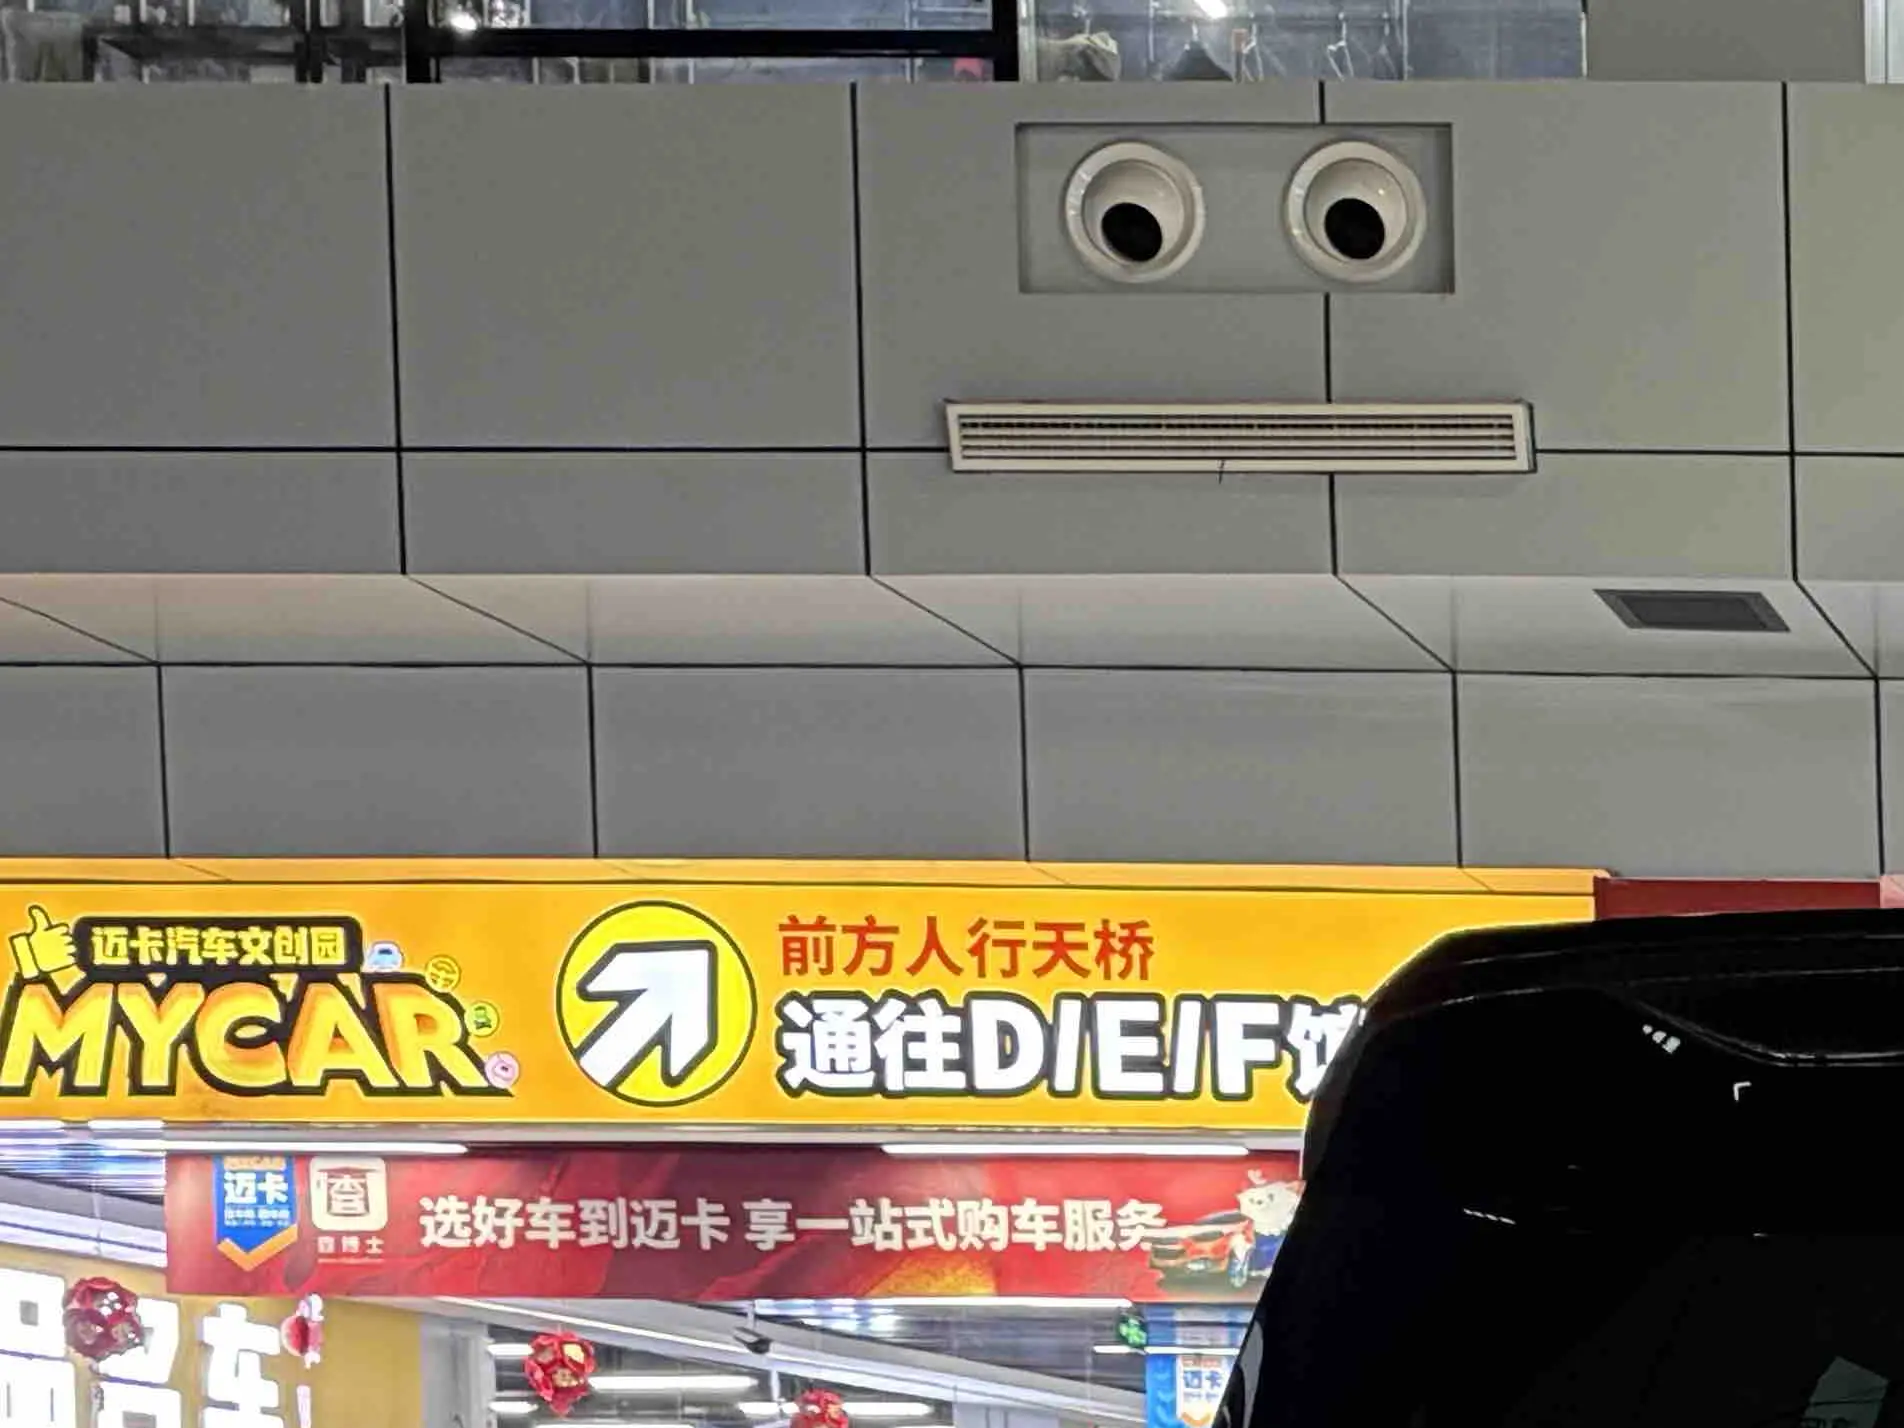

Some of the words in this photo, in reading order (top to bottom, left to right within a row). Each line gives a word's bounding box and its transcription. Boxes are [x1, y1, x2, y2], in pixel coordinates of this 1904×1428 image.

[91, 925, 346, 966] 迈卡汽车文创园
[778, 915, 1155, 981] 前方人行天桥
[0, 976, 492, 1094] MYCAR
[224, 1171, 290, 1204] 迈卡
[419, 1195, 731, 1251] 选好车到迈卡
[744, 1196, 1168, 1253] 享一站式购车服务
